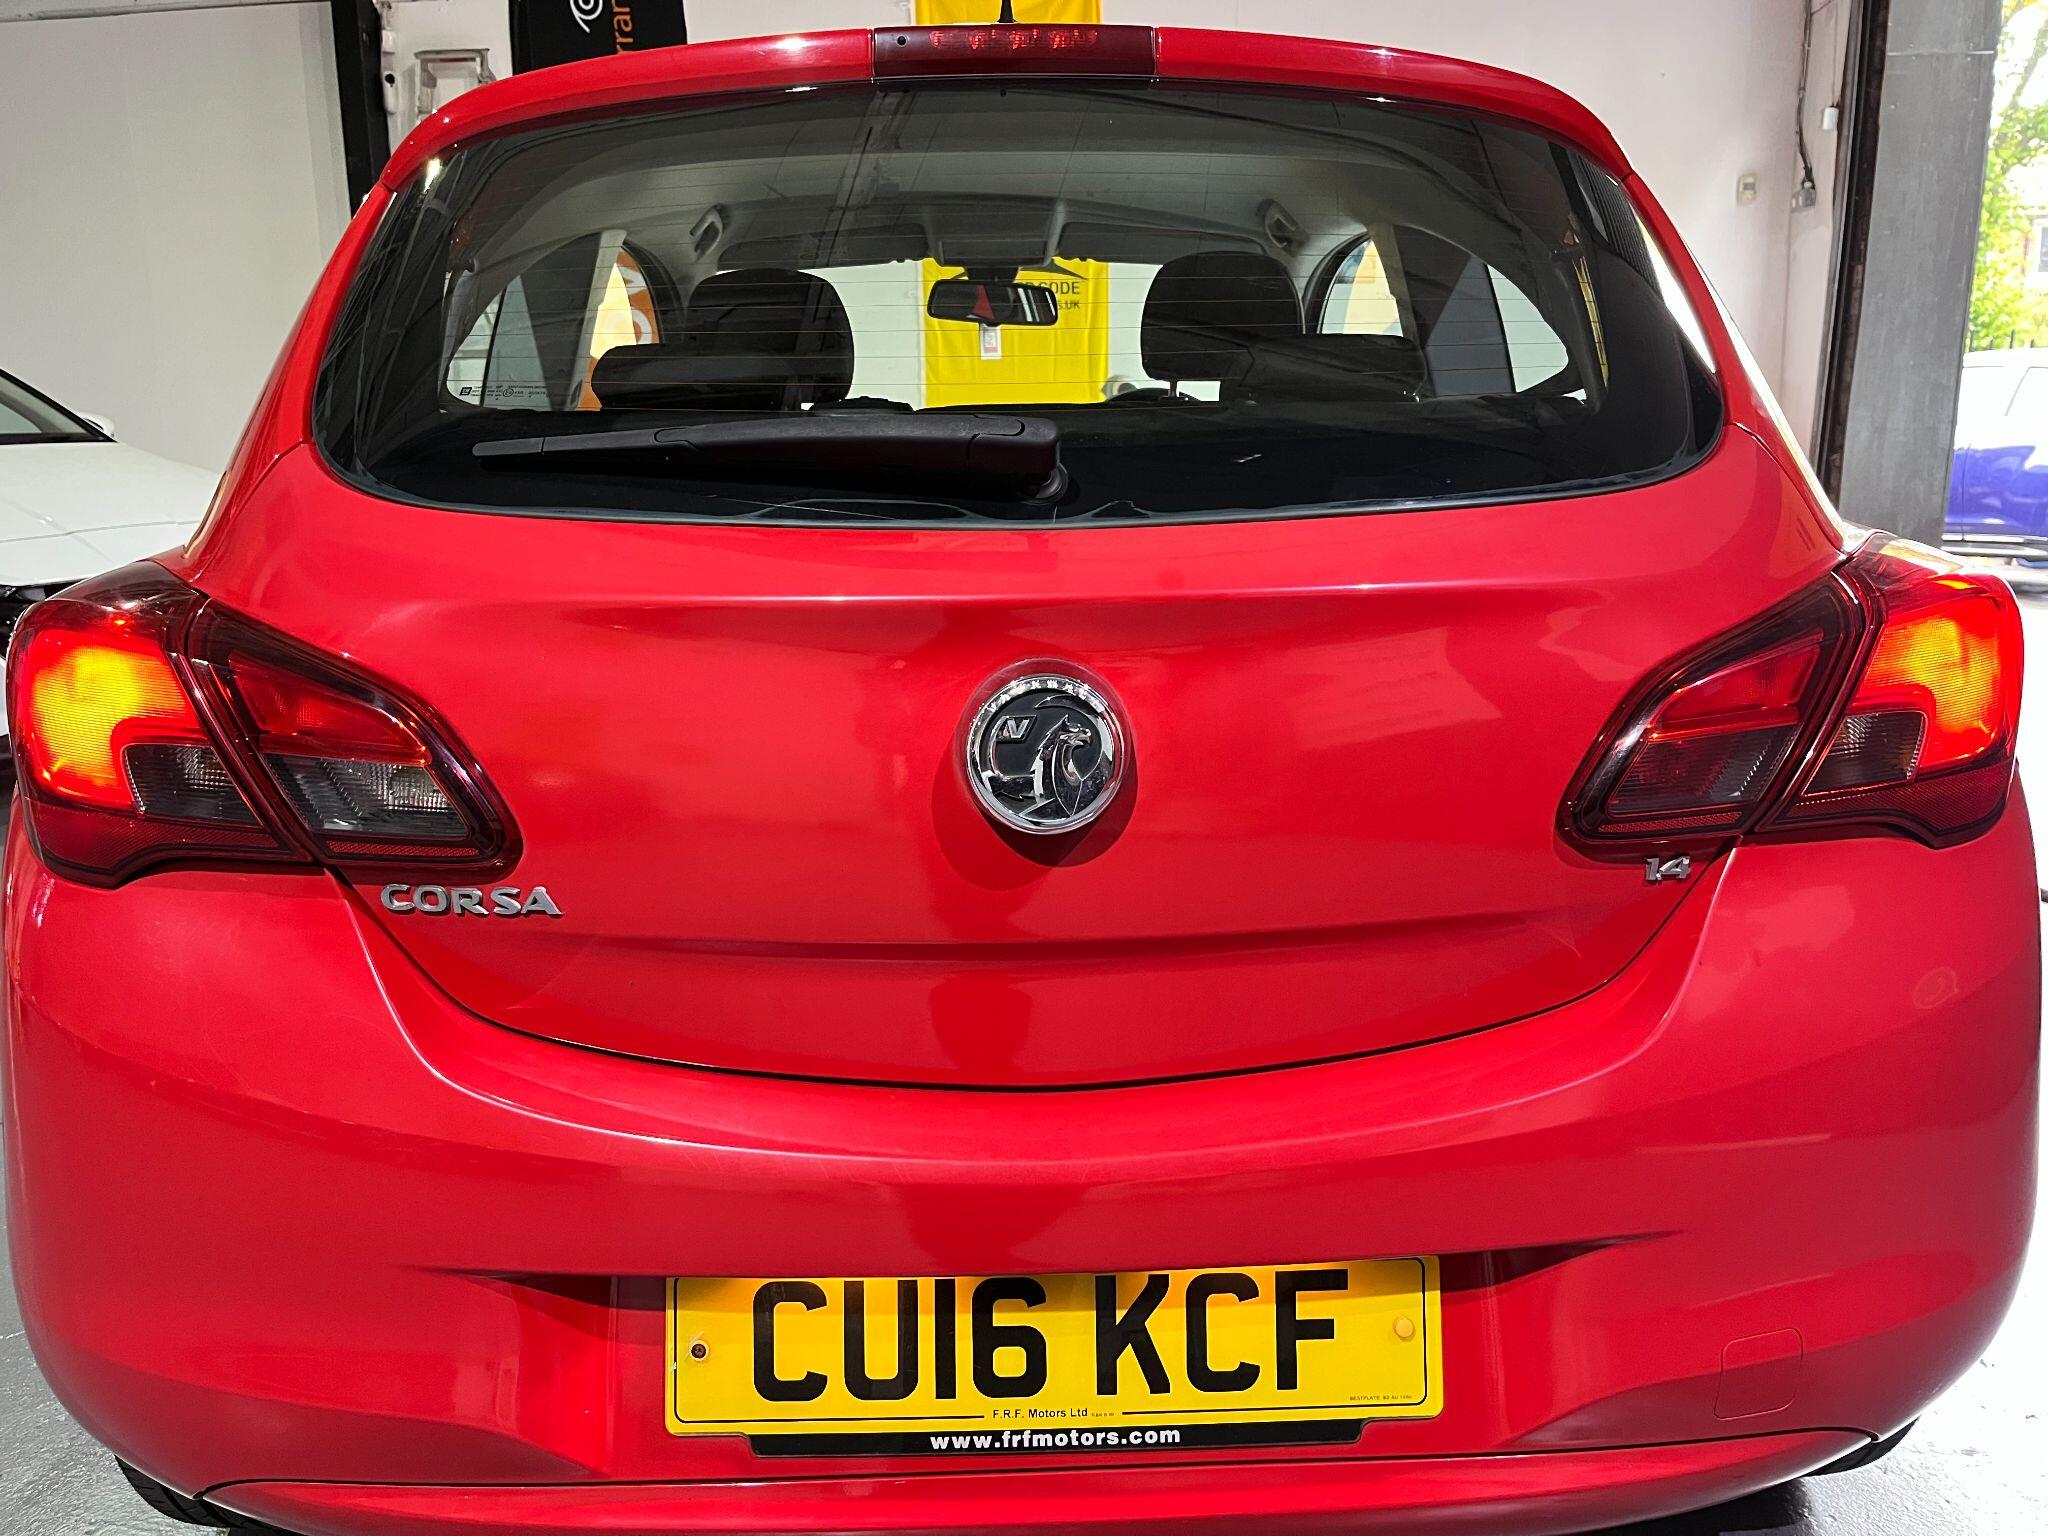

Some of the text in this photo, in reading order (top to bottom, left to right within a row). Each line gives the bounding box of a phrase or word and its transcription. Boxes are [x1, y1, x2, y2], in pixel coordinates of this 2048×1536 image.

[1040, 281, 1080, 294] ODE
[380, 883, 563, 915] CORSA
[753, 1269, 1349, 1402] CU16 KCF
[993, 1409, 1025, 1419] F.R.F.
[1028, 1408, 1067, 1418] Motors
[1070, 1407, 1088, 1417] Ltd
[930, 1429, 1181, 1450] www.frfmotors.com
